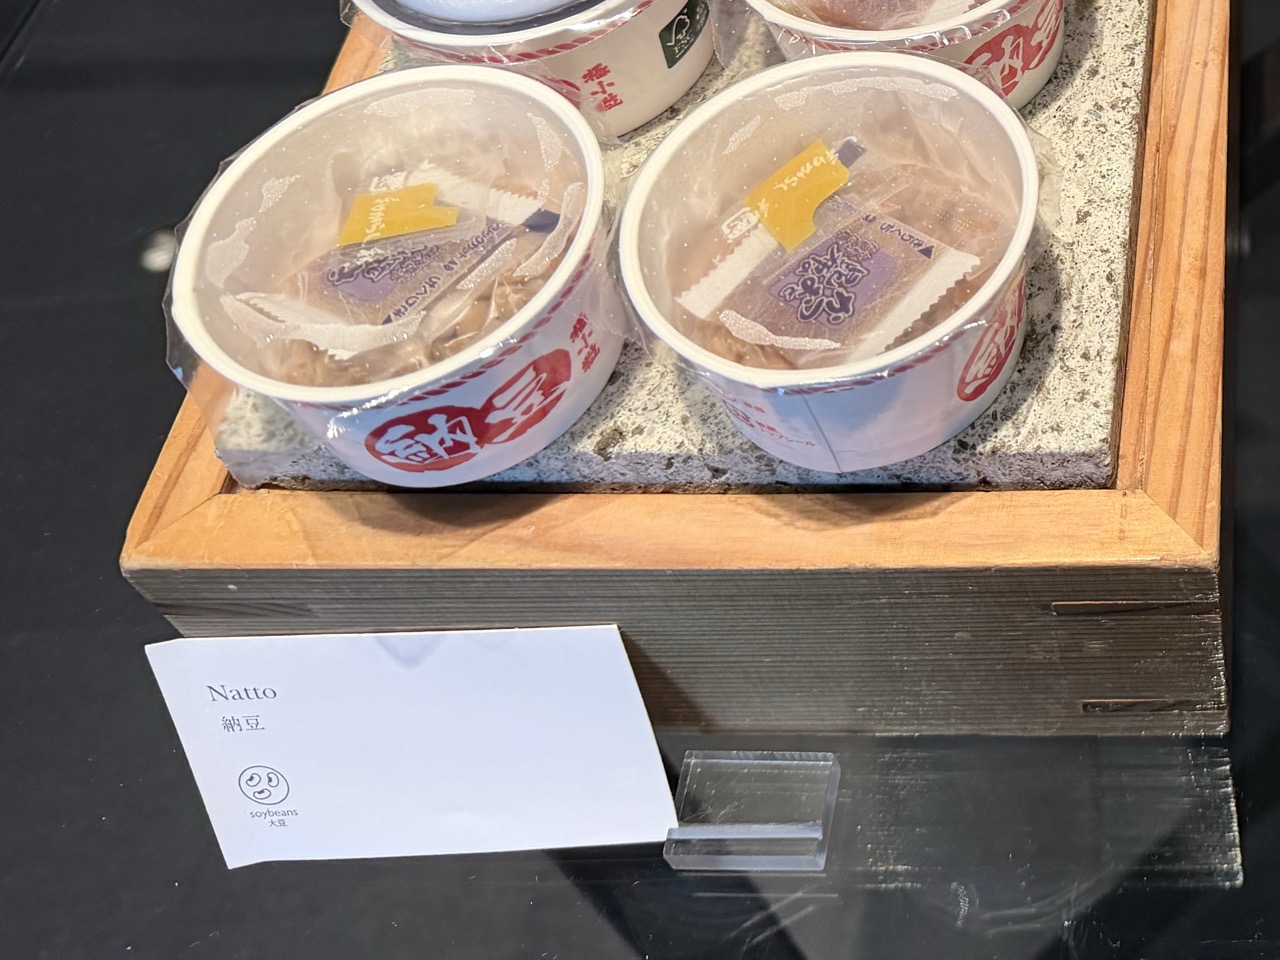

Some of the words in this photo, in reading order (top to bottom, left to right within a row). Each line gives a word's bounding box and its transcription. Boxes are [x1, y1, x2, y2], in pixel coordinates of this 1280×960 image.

[879, 221, 927, 249] きりくち
[796, 242, 869, 289] 昆布の
[390, 274, 442, 318] きりくち
[779, 274, 856, 325] かつおと
[206, 683, 278, 703] Natto
[221, 714, 266, 733] 納豆
[249, 806, 299, 820] soybeans
[267, 819, 288, 829] 大豆
